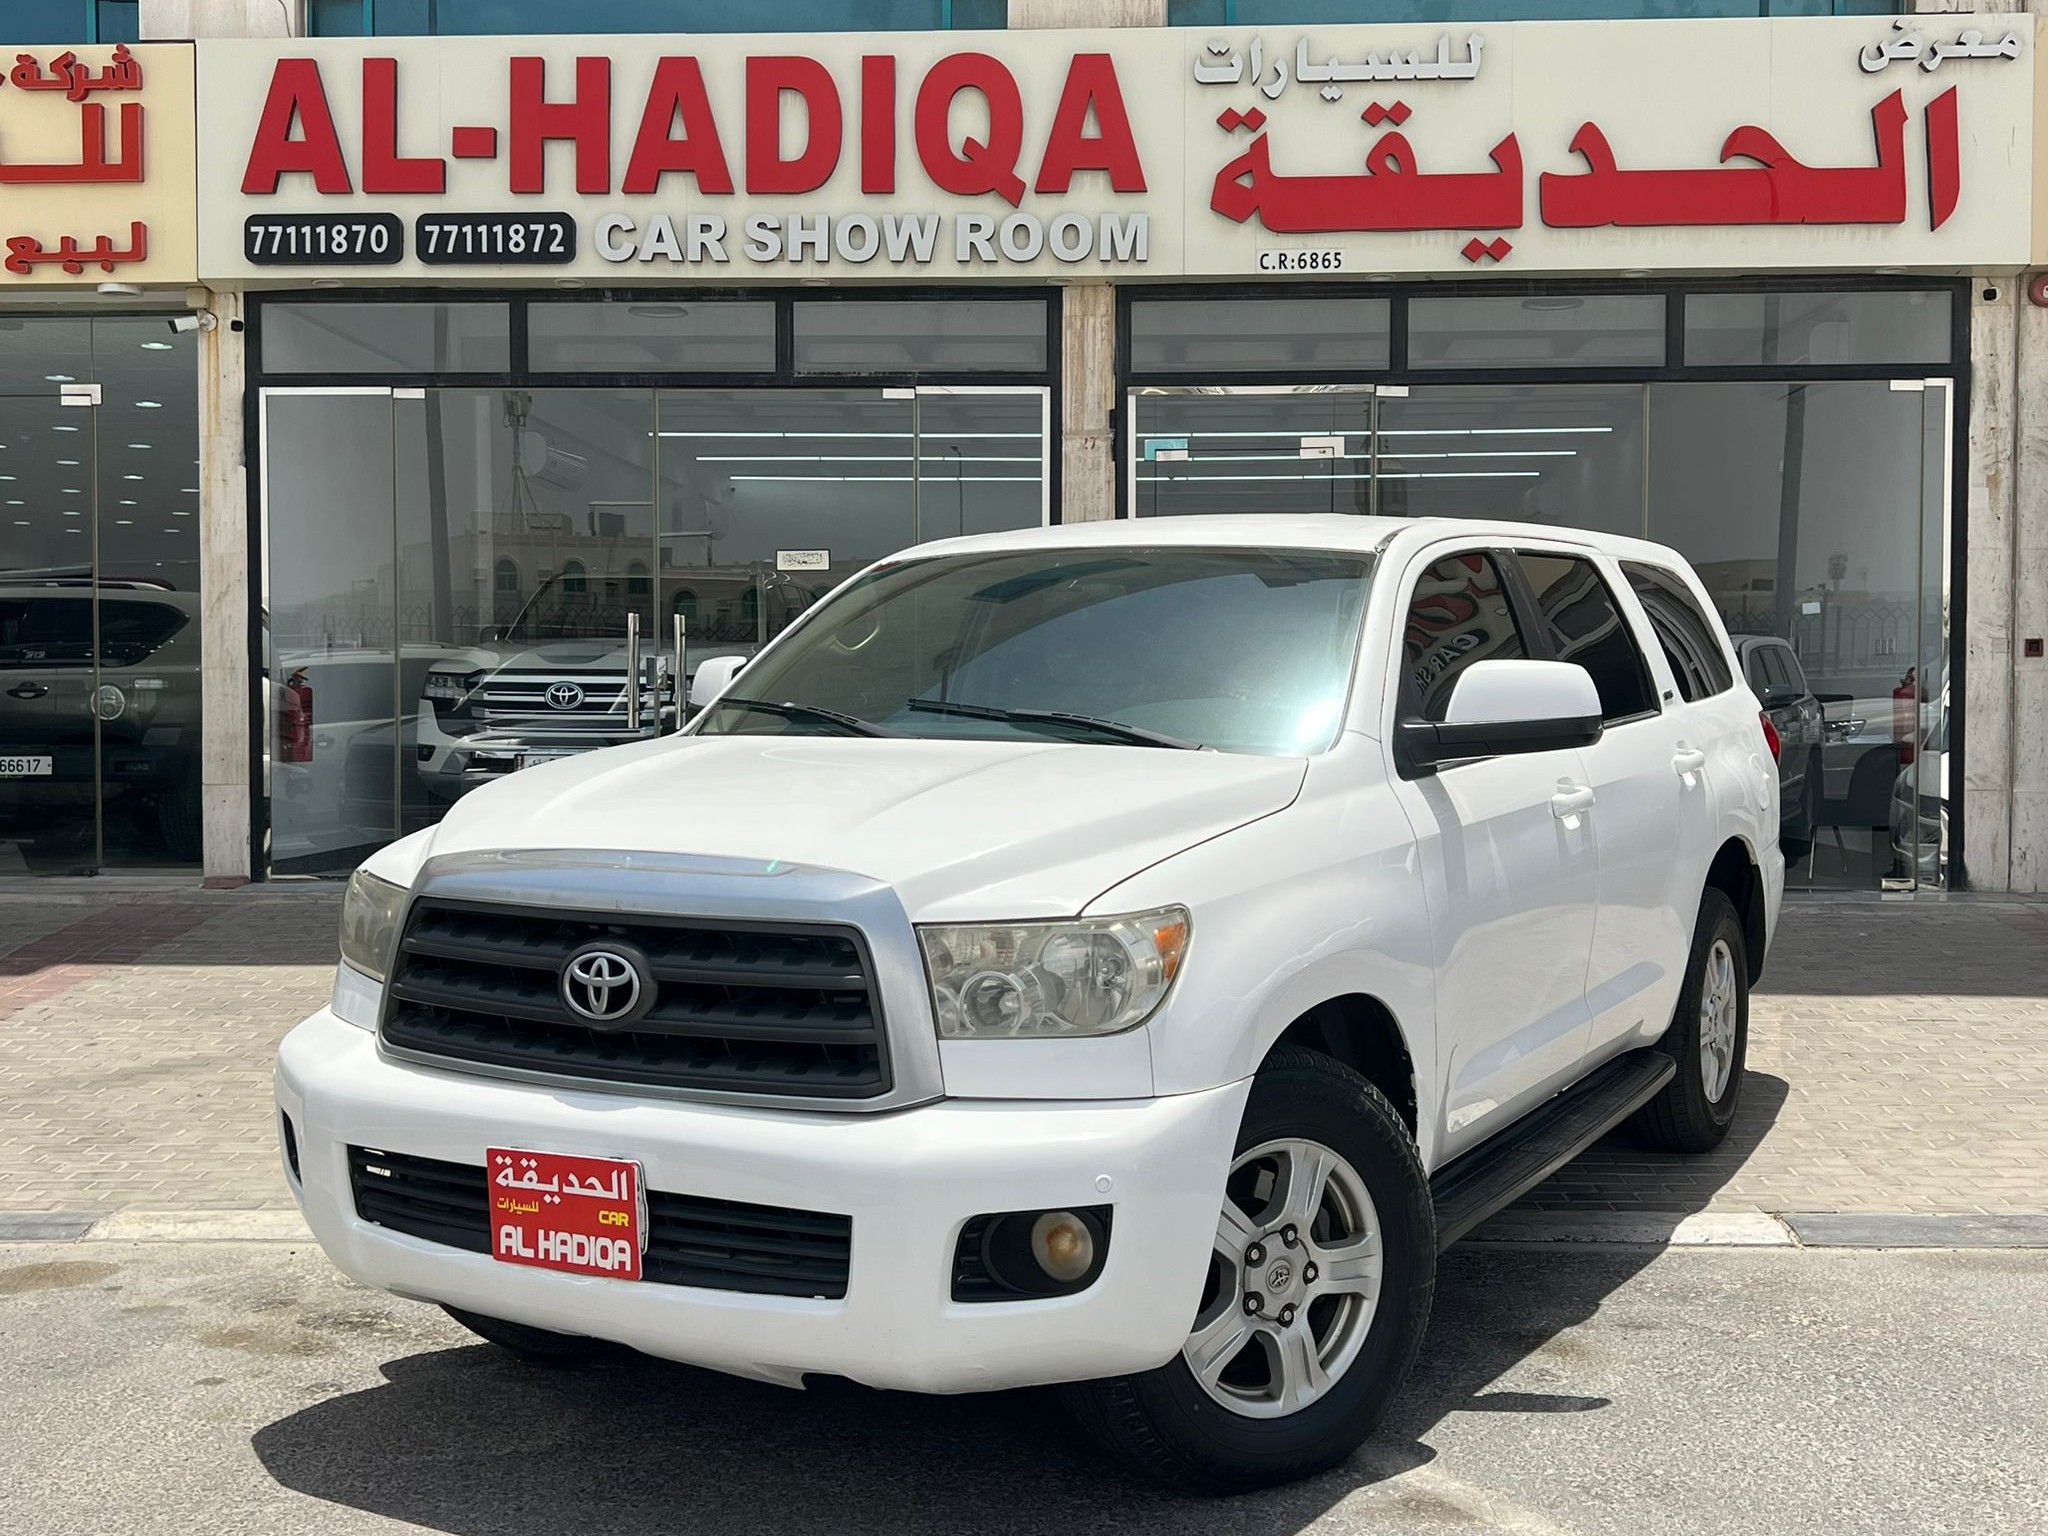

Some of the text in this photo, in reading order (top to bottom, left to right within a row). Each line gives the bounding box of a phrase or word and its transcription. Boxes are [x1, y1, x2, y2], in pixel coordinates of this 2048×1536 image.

[1193, 32, 1485, 101] للسيارات
[1858, 19, 2022, 74] معرض
[10, 43, 143, 102] شركة
[241, 53, 1148, 208] AL-HADIQA
[1210, 84, 1959, 264] الحديقة
[5, 220, 147, 274] لبيع
[250, 225, 388, 254] 77111870
[425, 223, 565, 253] 77111872
[594, 213, 1148, 263] CAR SHOW ROOM
[1259, 251, 1342, 270] C.R:6865
[495, 1155, 628, 1204] الحديقة
[496, 1197, 539, 1215] للسيارات
[598, 1210, 629, 1227] CAR
[500, 1224, 631, 1271] AL HADIQA
